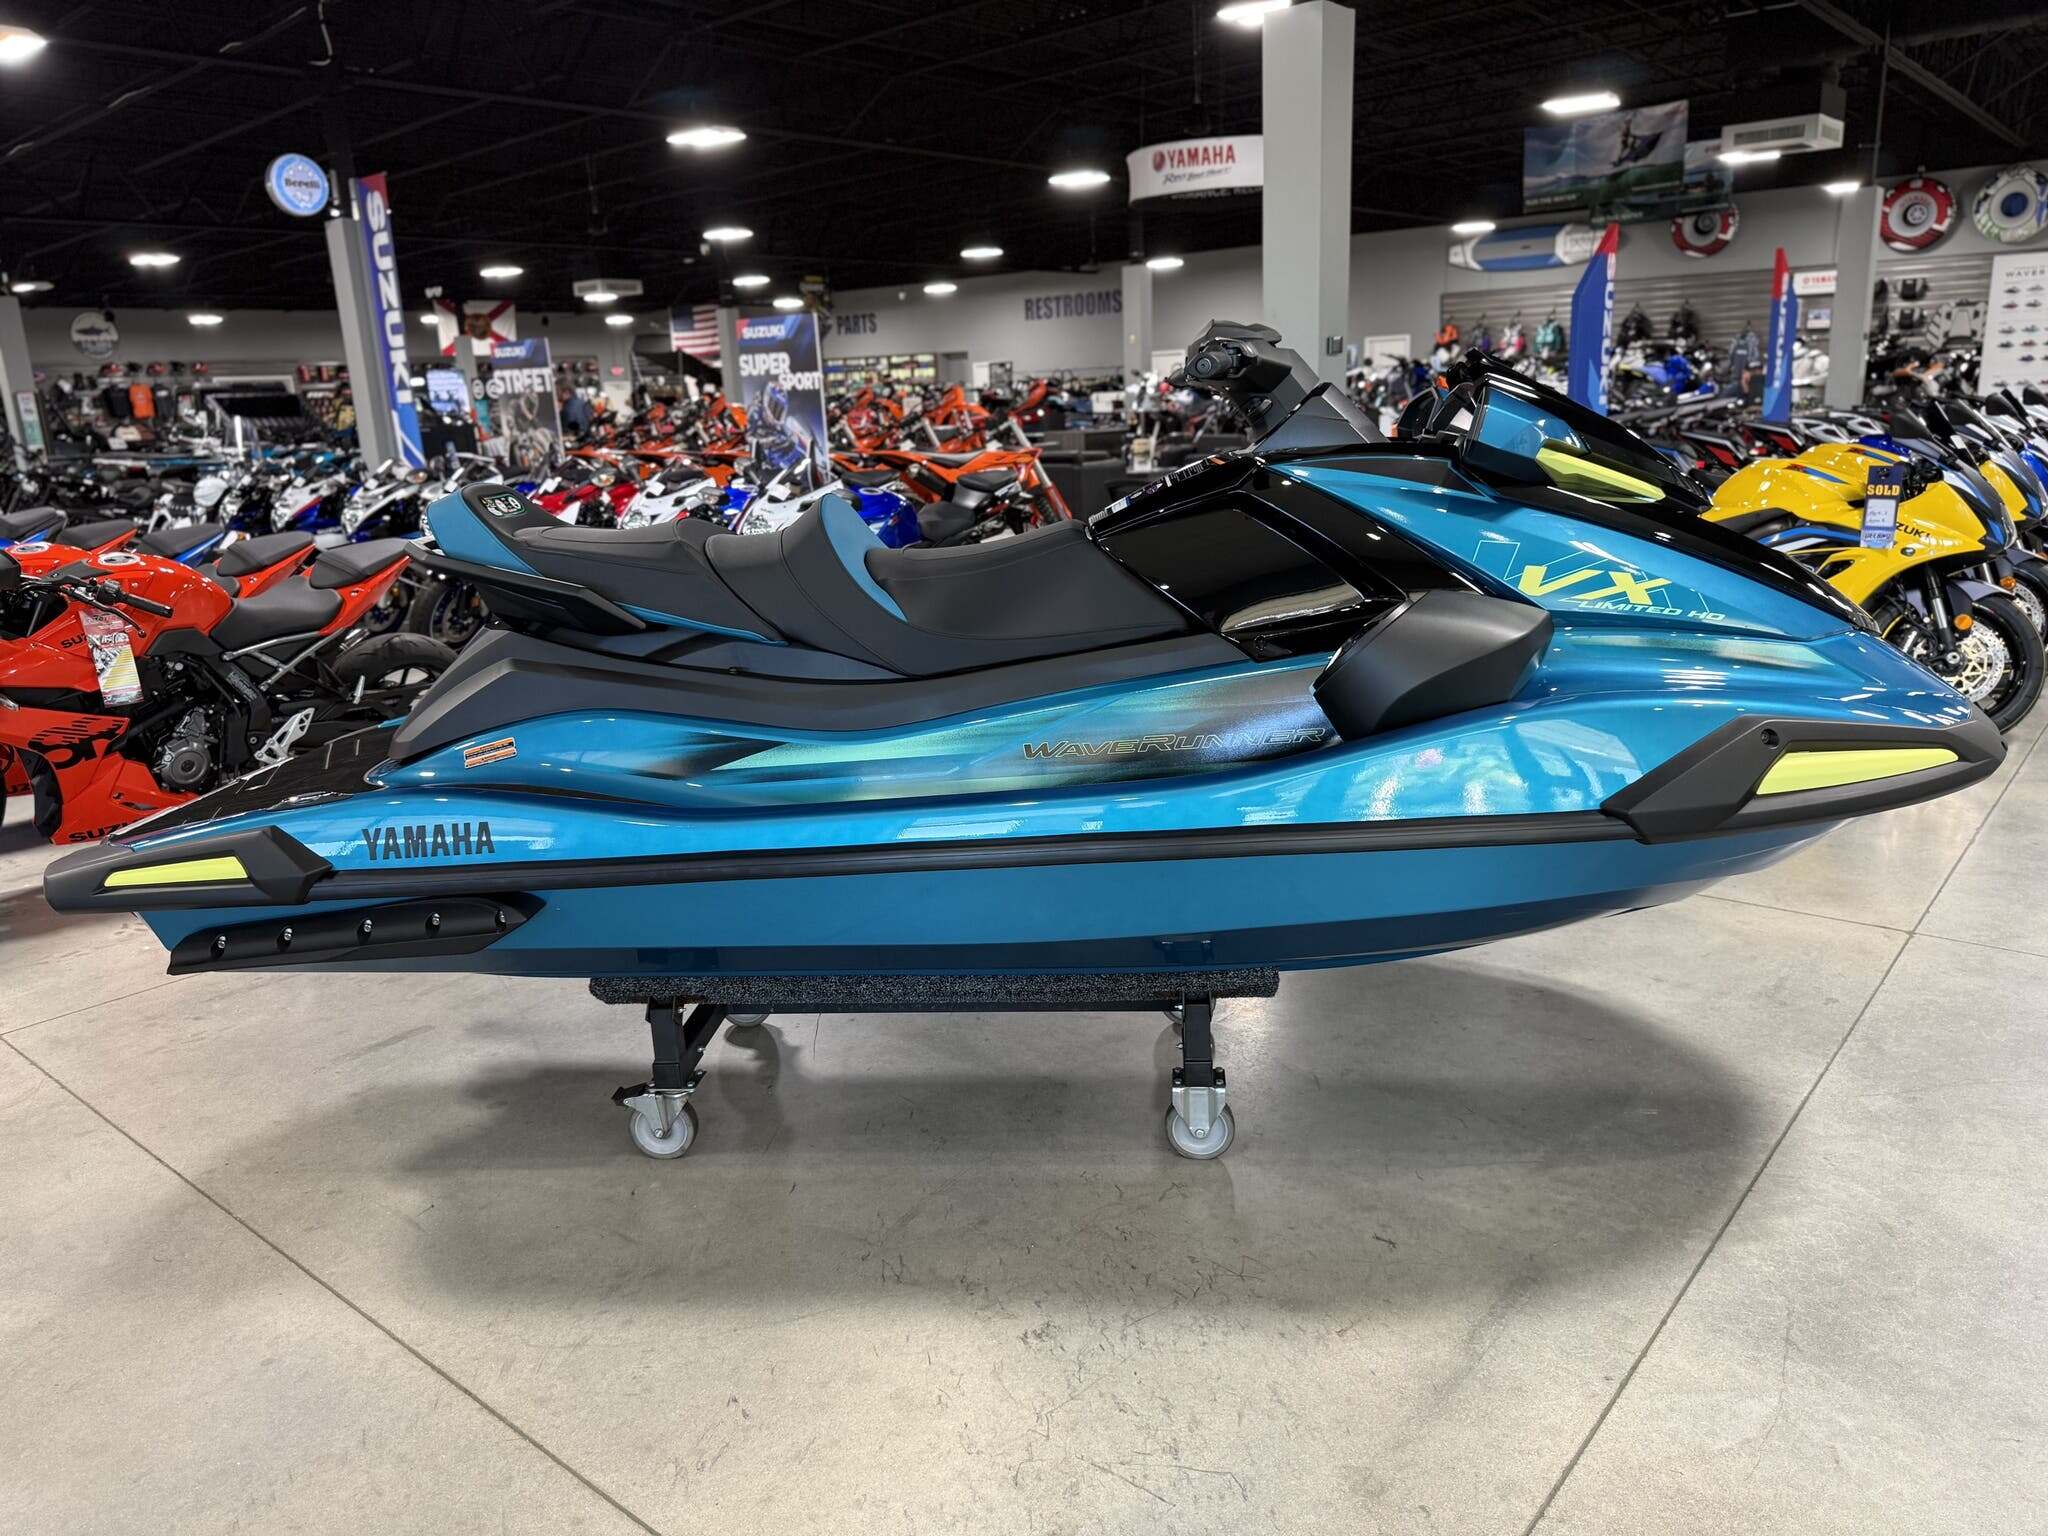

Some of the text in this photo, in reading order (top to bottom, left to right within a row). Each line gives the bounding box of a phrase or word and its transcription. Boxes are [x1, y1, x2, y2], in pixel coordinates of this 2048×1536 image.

[1167, 144, 1236, 168] YAMAHA
[2005, 268, 2047, 279] WAVER
[366, 190, 413, 404] SUZUKI
[1024, 288, 1122, 321] RESTROOMS
[741, 324, 786, 340] SUZUKI
[836, 312, 877, 335] PARTS
[739, 351, 791, 376] SUPER
[493, 367, 553, 395] STREET
[778, 370, 823, 391] SPORT
[1867, 484, 1900, 496] SOLD
[1896, 521, 1931, 538] ZUKI
[1517, 564, 1673, 605] VX
[1577, 600, 1683, 616] LIMITED
[361, 821, 496, 861] YAMAHA
